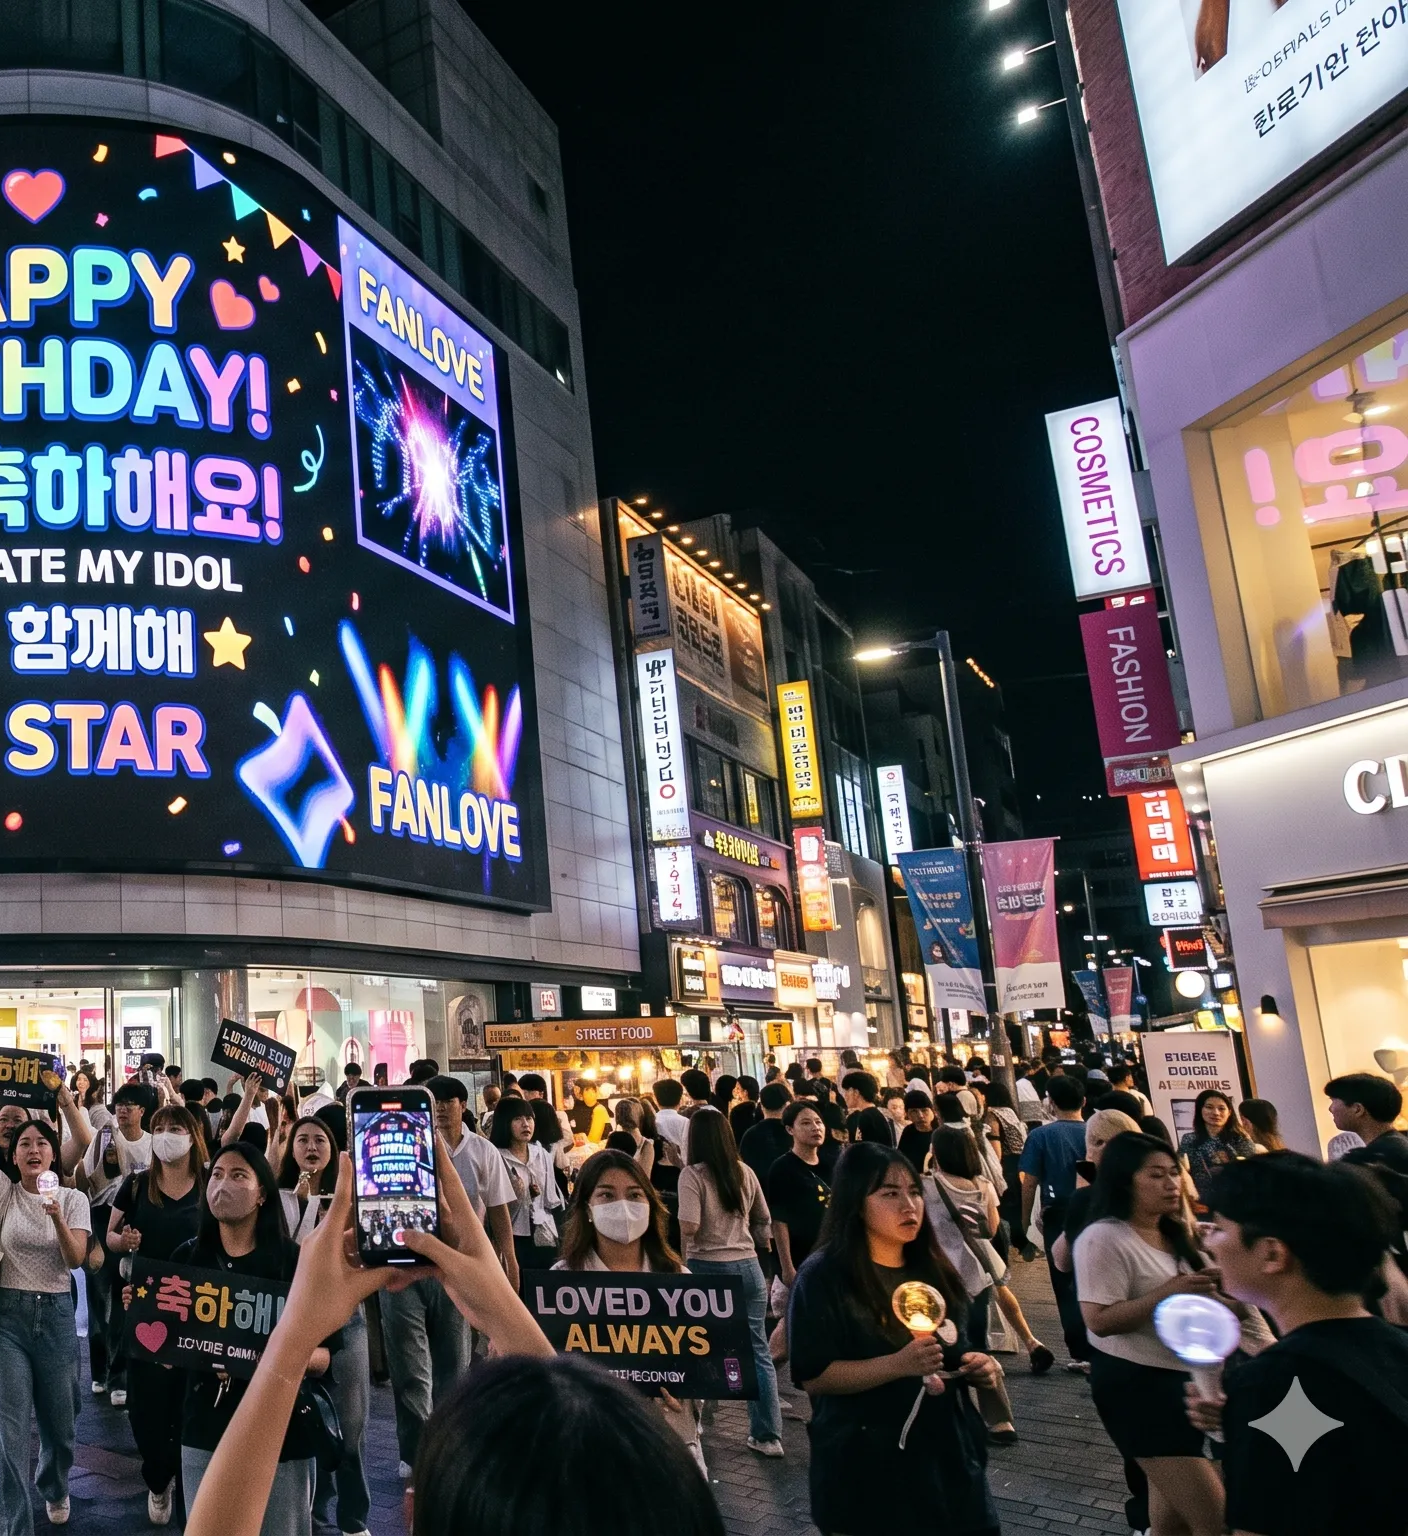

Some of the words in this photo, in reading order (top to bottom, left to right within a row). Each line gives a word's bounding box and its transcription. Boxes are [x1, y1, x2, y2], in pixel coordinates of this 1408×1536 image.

[358, 266, 486, 403] FANLOVE
[1070, 416, 1125, 576] COSMETICS
[77, 549, 144, 586] MY
[154, 555, 243, 593] IDOL
[7, 602, 197, 677] 함께해
[1107, 625, 1152, 744] FASHION
[4, 701, 212, 779] STAR
[368, 762, 523, 861] FANLOVE
[576, 1027, 617, 1041] STREET
[620, 1026, 654, 1040] FOOD
[535, 1286, 654, 1316] LOVED
[658, 1287, 734, 1319] YOU
[565, 1323, 711, 1356] ALWAYS
